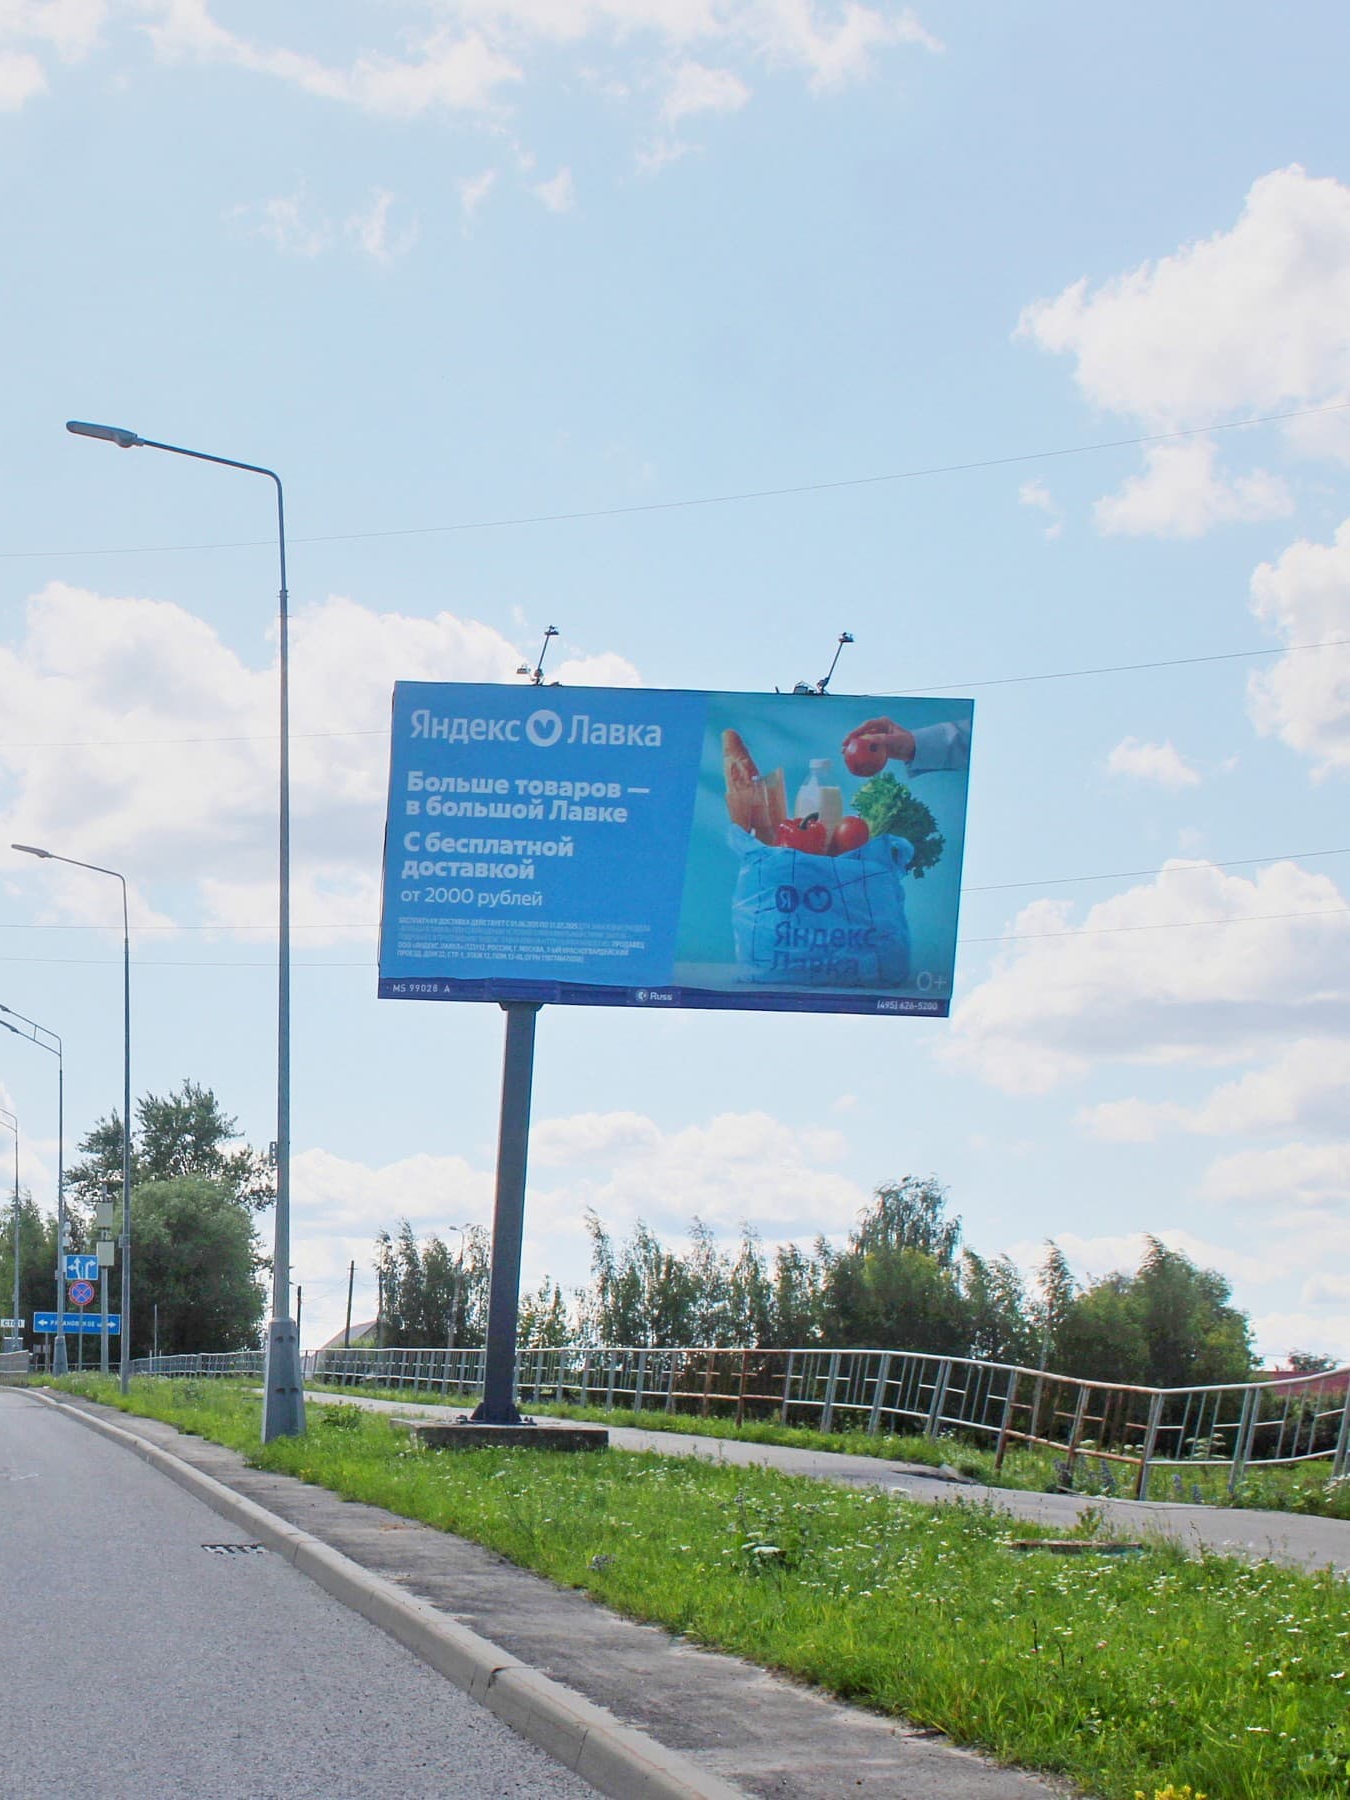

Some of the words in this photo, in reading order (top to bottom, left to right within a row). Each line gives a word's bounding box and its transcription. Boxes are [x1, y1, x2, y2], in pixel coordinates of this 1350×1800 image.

[409, 708, 522, 744] Яндекс
[566, 714, 663, 747] Лавка
[406, 770, 510, 794] Больше
[514, 778, 622, 801] товаров
[405, 800, 420, 816] в
[425, 795, 544, 820] большой
[548, 799, 629, 823] Лавке
[403, 831, 421, 852] С
[424, 831, 574, 857] бесплатной
[401, 858, 535, 880] доставкой
[400, 889, 421, 902] от
[424, 886, 474, 904] 2000
[477, 889, 543, 908] рублей
[774, 921, 877, 951] Яндекс
[392, 983, 407, 993] MS
[409, 983, 438, 993] 99028
